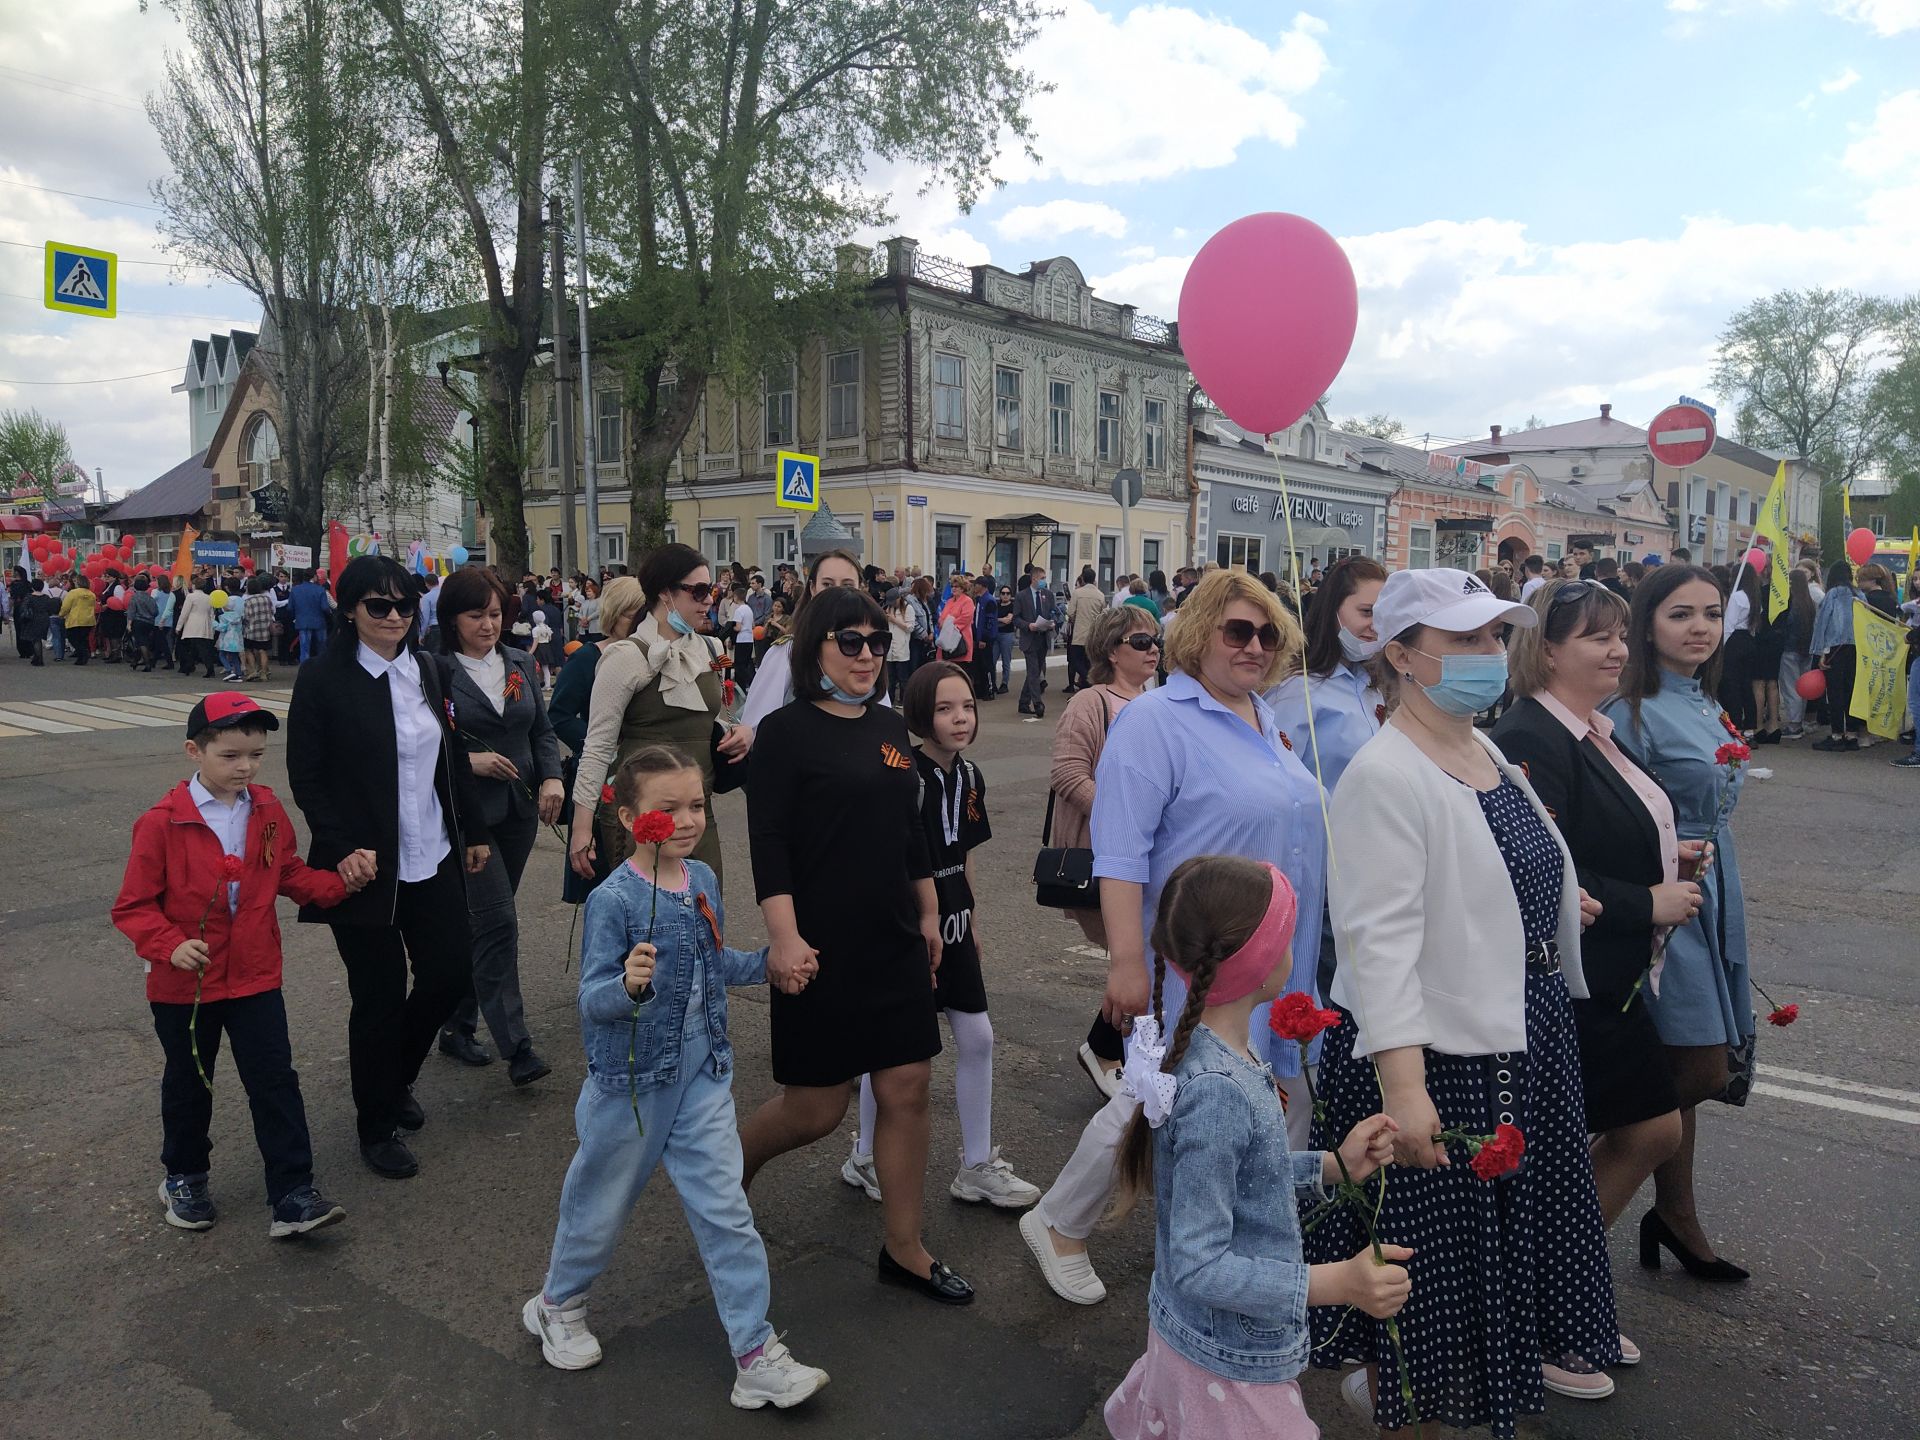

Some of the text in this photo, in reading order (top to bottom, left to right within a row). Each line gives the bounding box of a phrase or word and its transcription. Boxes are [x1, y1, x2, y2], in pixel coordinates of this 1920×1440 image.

[1234, 494, 1259, 513] café
[1271, 494, 1332, 526] AVENUE
[1338, 510, 1363, 529] кафе
[197, 549, 236, 558] ОБРАЗОВАНИЕ
